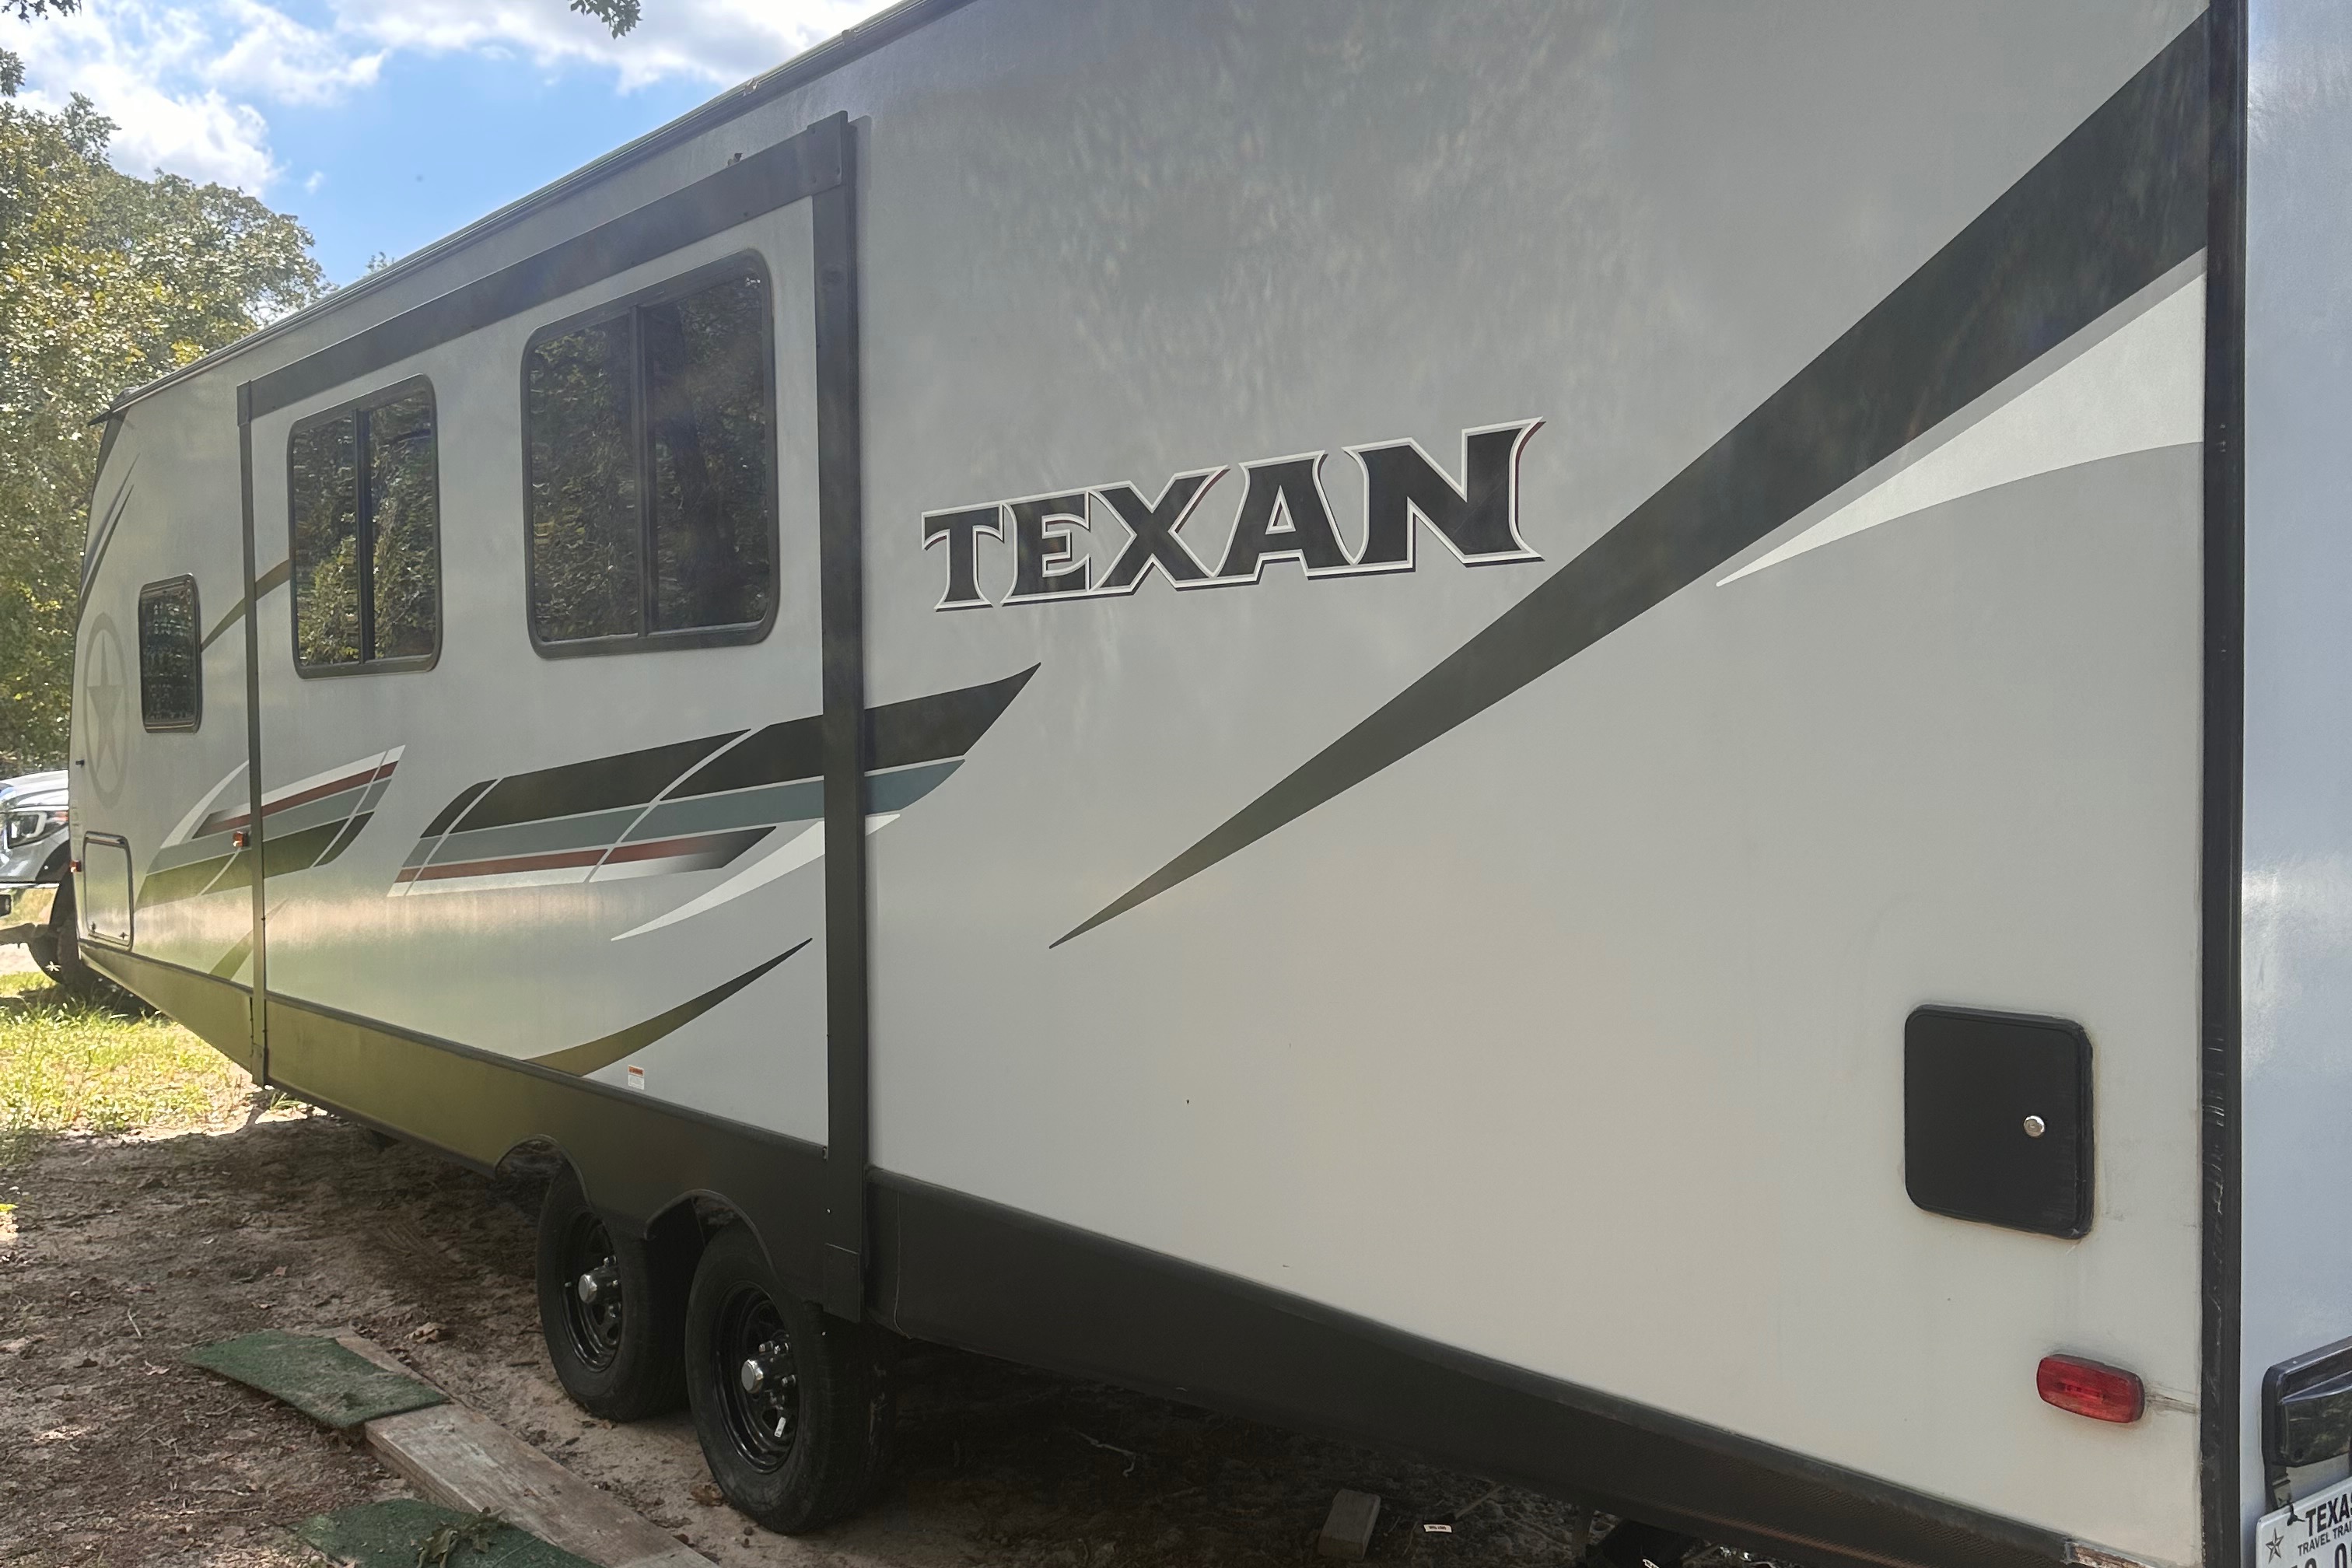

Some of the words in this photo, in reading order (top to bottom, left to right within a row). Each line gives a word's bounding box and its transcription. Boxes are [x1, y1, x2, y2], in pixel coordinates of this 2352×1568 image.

[922, 416, 1546, 612] TEXAN
[2305, 1492, 2352, 1538] TEXA
[2298, 1532, 2331, 1556] TRAVEL
